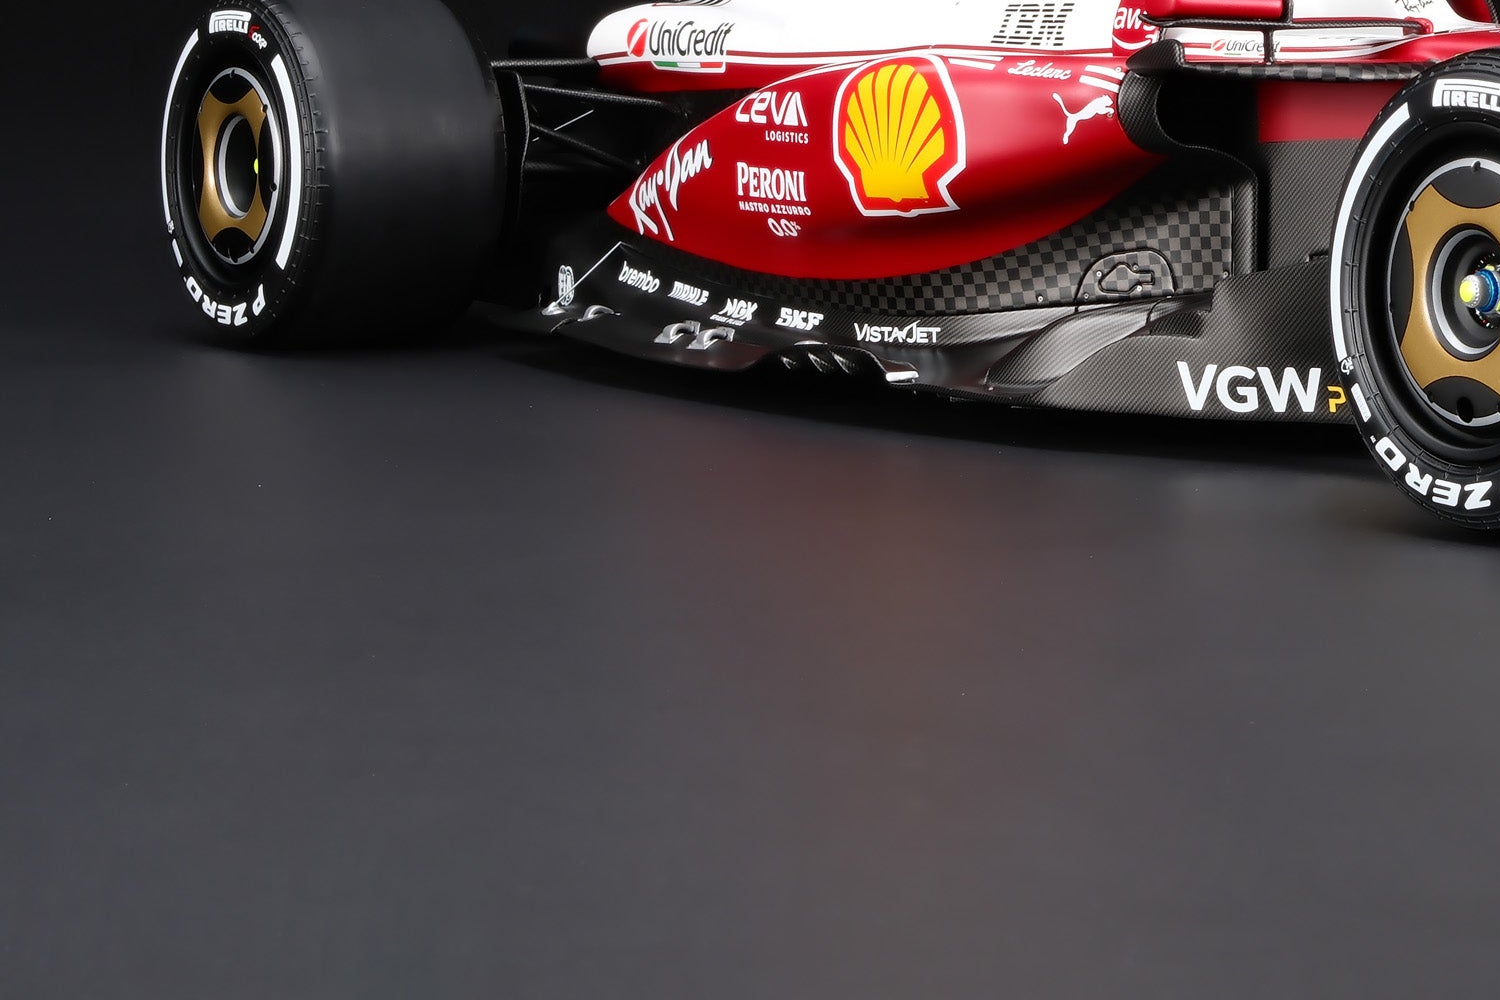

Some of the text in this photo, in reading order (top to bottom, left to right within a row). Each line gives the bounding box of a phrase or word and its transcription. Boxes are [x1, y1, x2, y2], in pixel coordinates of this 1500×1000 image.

[209, 10, 252, 34] PIRELLI
[990, 3, 1075, 47] IBM
[650, 20, 737, 57] UniCredit
[1007, 59, 1072, 81] Leclerc
[765, 129, 810, 145] LOGISTICS
[736, 160, 808, 203] PERONI
[738, 200, 812, 217] NASTRO AZZURRO
[618, 260, 661, 294] brembo
[186, 276, 266, 327] P ZERO
[667, 280, 710, 307] MAHLE
[718, 297, 758, 322] NGK
[775, 306, 825, 331] SKF
[1176, 360, 1323, 413] VGW
[1374, 436, 1493, 511] ZERO
